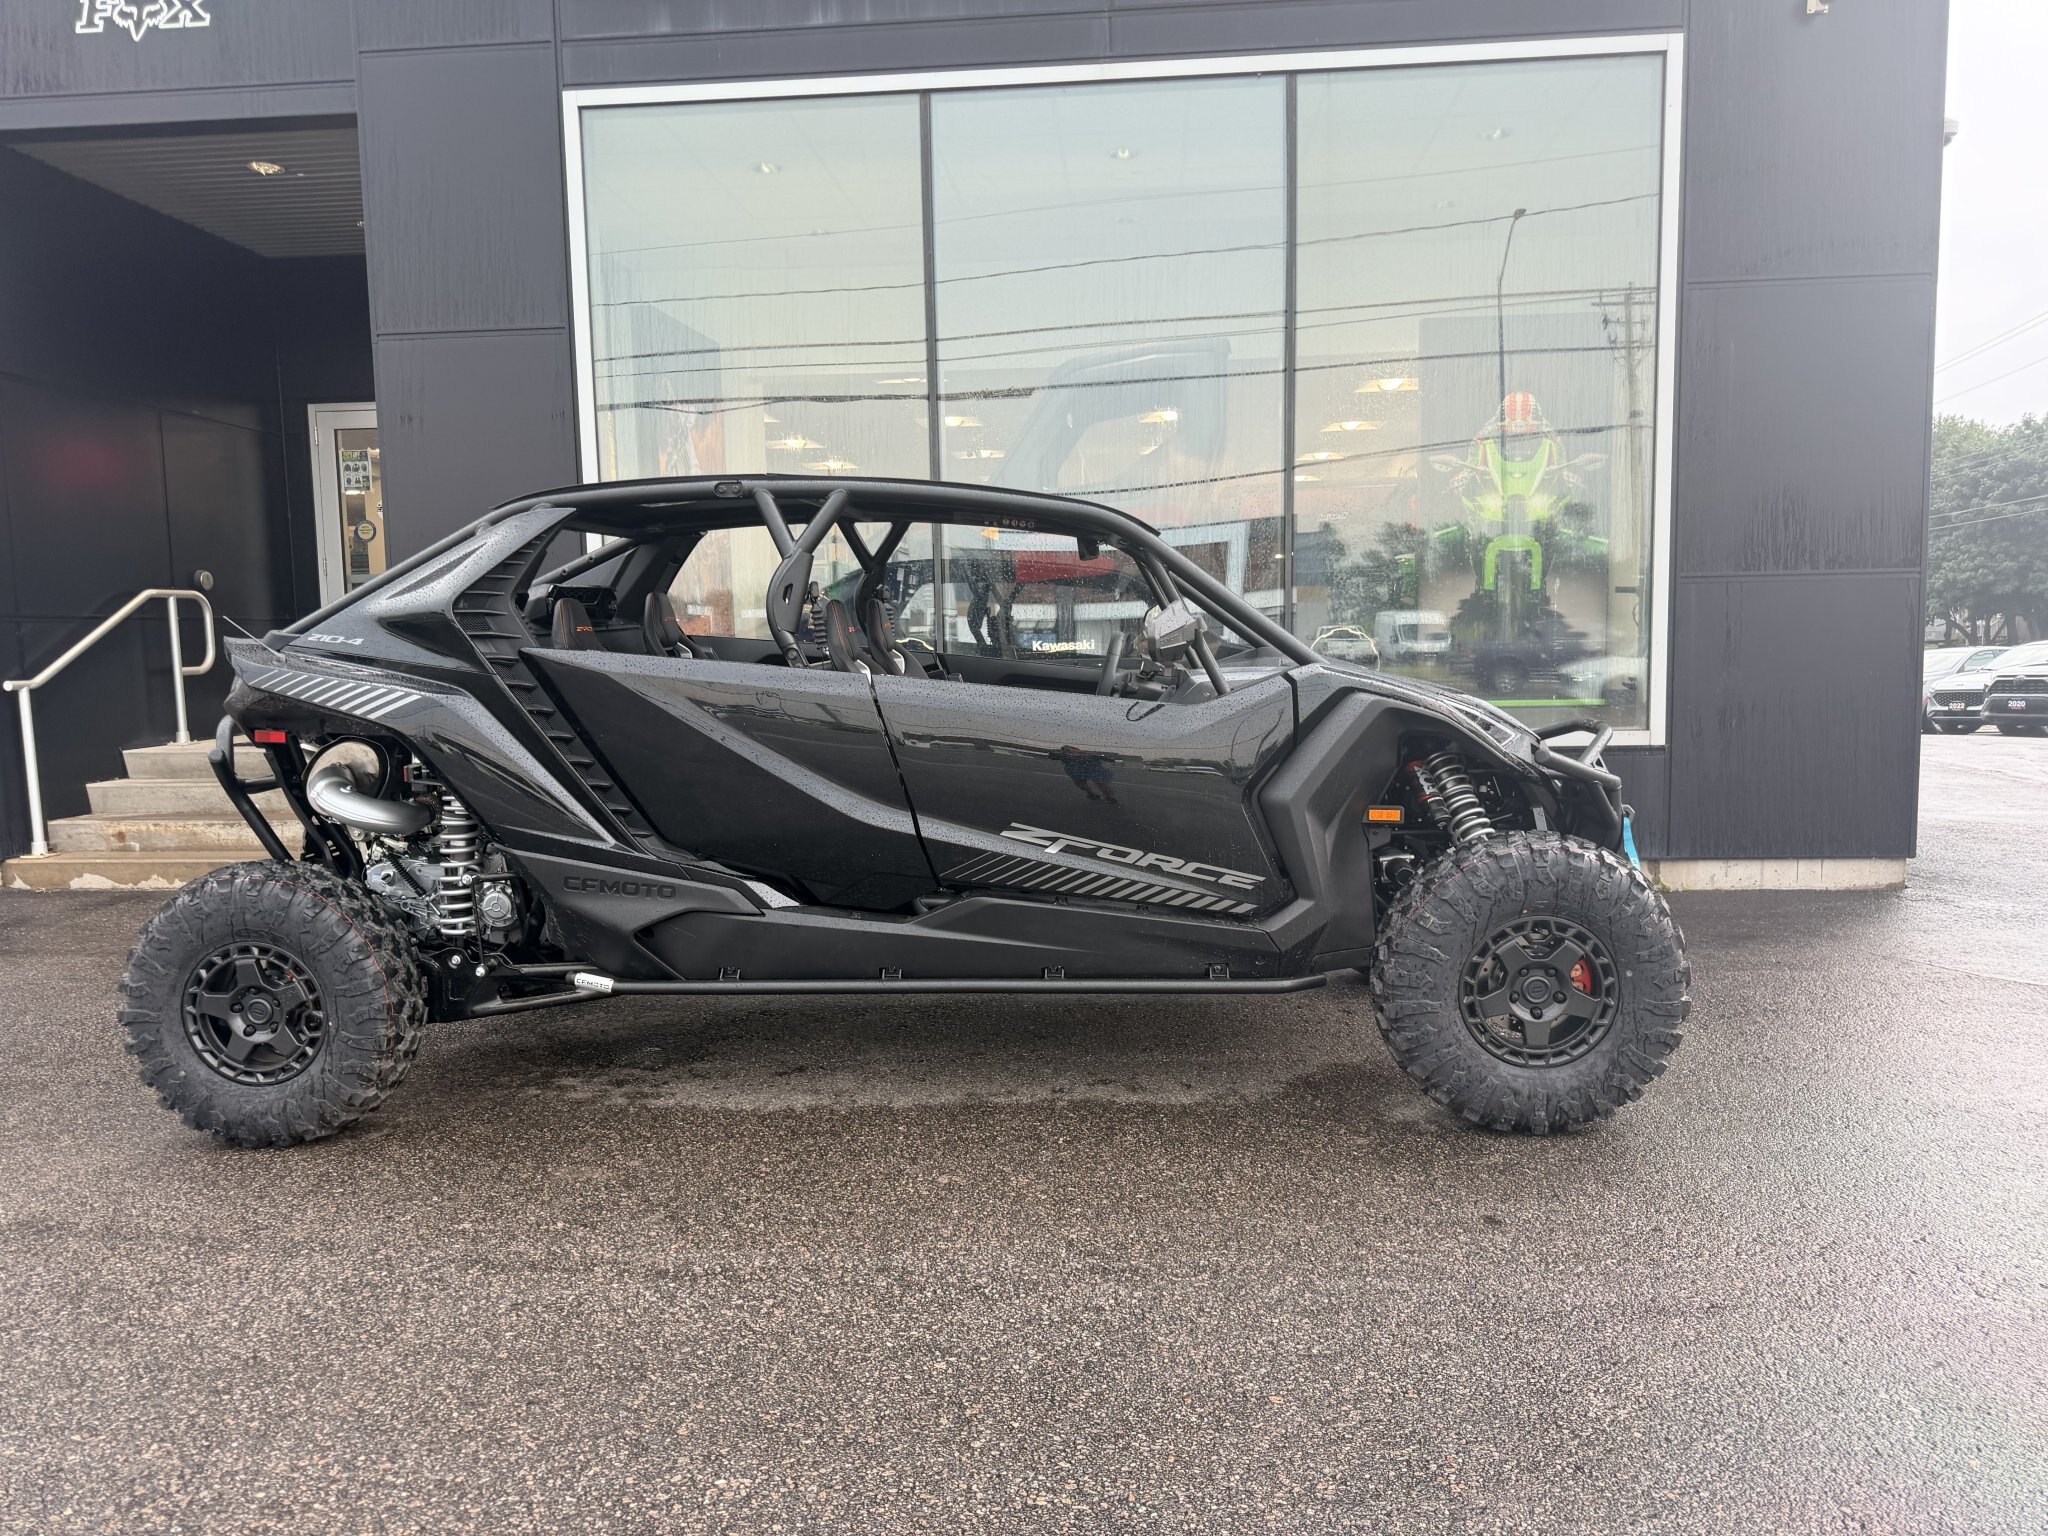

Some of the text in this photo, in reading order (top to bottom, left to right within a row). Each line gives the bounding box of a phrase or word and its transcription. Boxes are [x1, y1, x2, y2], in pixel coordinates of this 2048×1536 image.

[1032, 640, 1095, 651] Kawasaki
[1000, 822, 1266, 890] ZFORCE
[563, 876, 677, 900] CFMOTO
[575, 978, 611, 991] CFMOTO
